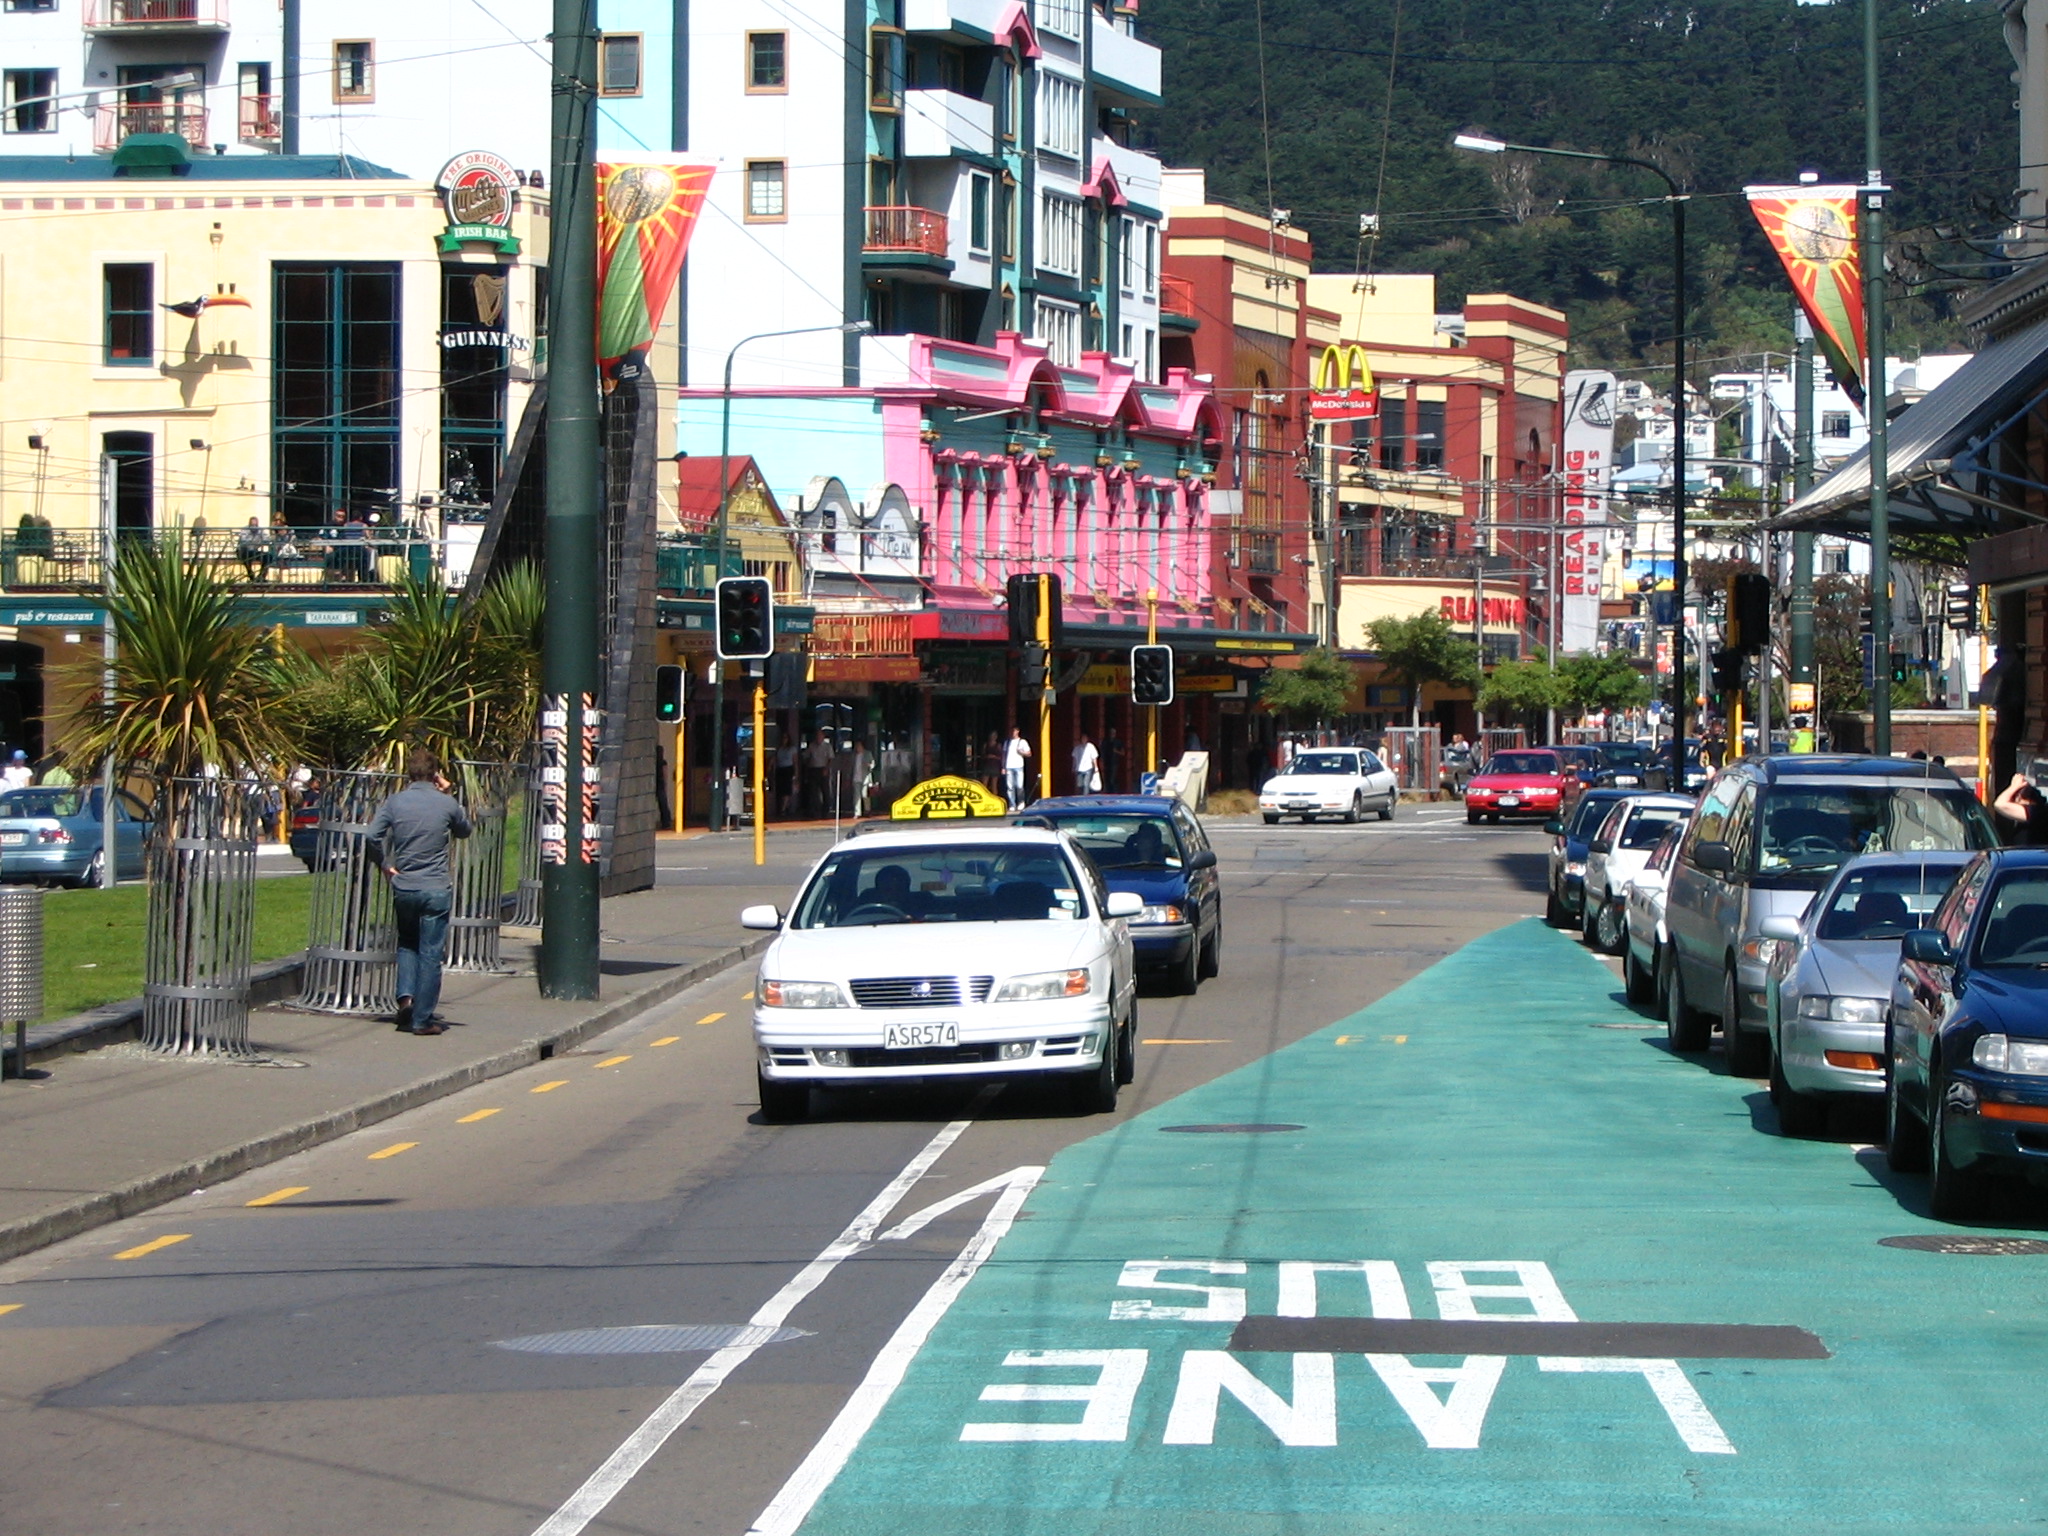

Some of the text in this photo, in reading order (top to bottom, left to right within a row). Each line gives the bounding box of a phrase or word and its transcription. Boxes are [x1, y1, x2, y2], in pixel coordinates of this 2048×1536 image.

[444, 154, 518, 187] THE ORIGINAL
[454, 226, 508, 241] IRISH BAR
[443, 331, 532, 351] GUINNESS
[1565, 450, 1585, 595] READING
[13, 610, 33, 626] pub
[47, 612, 94, 621] restaurant
[913, 788, 983, 801] WELLINGTON
[928, 800, 967, 810] TAXI
[887, 1025, 957, 1046] ASR574
[1109, 1260, 1580, 1323] BUS
[959, 1348, 1738, 1456] LANE
